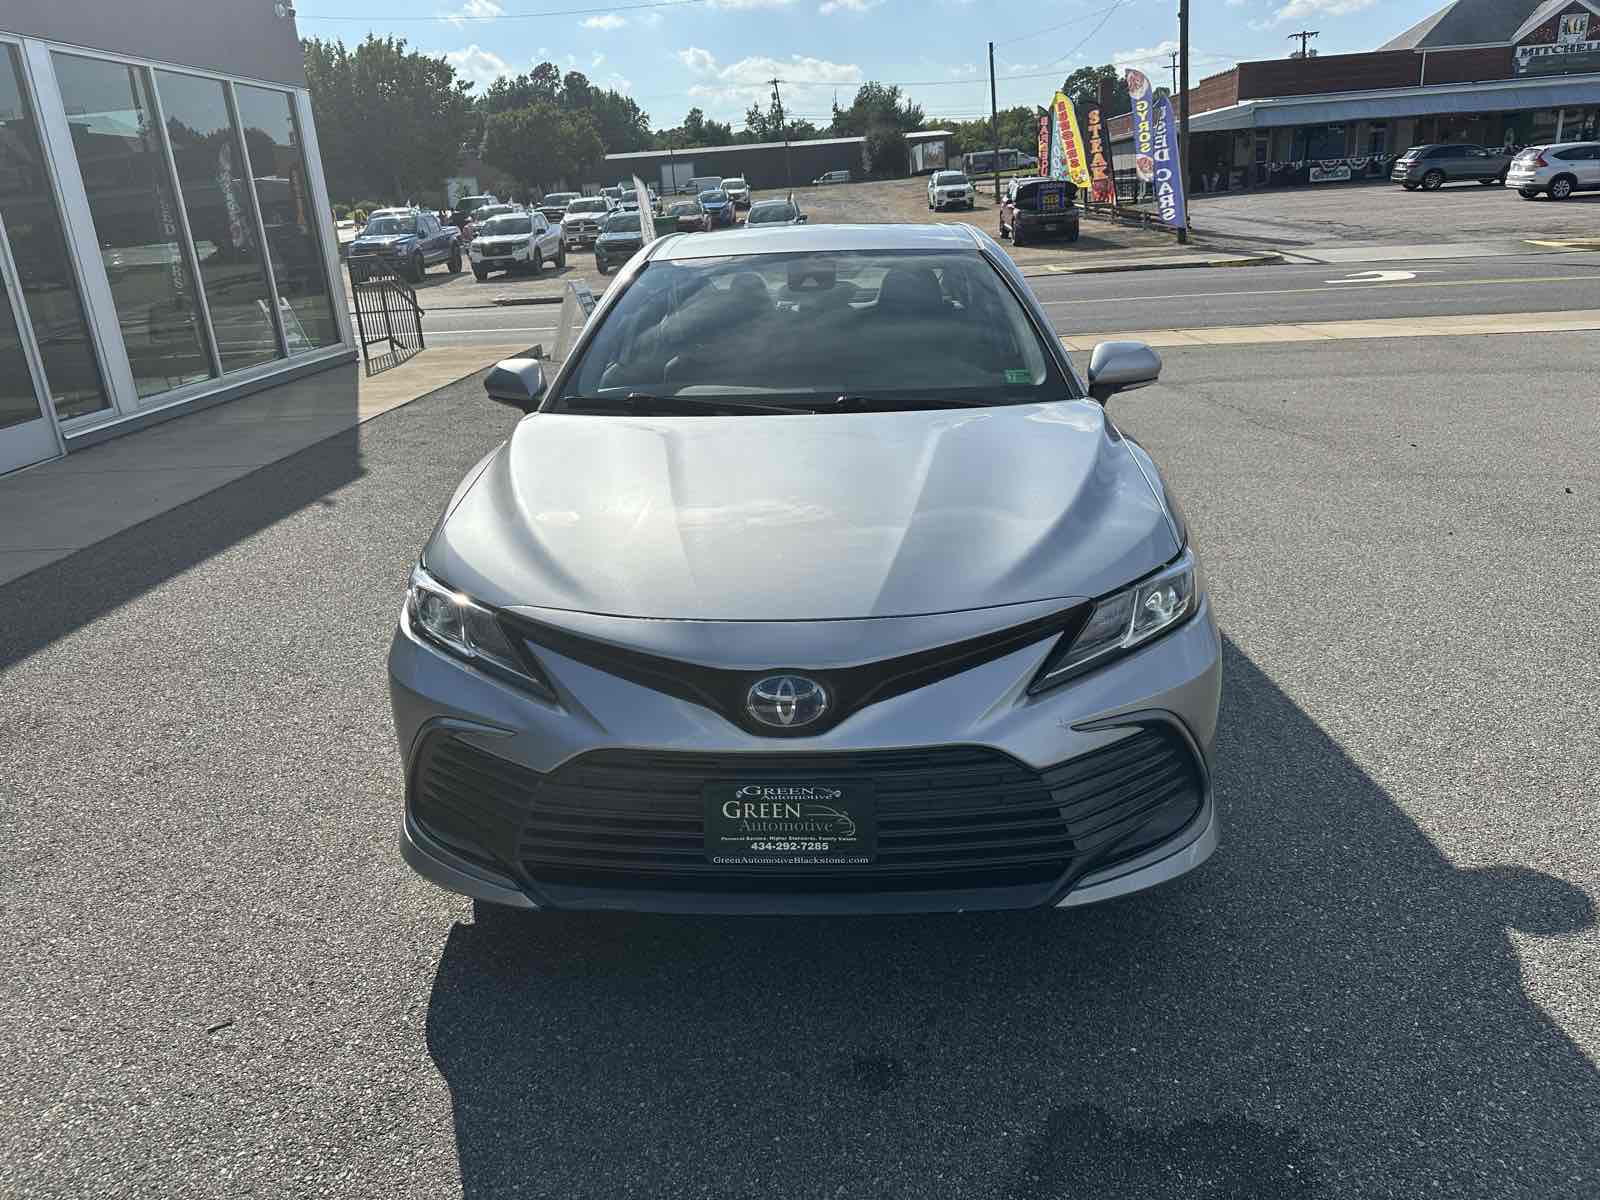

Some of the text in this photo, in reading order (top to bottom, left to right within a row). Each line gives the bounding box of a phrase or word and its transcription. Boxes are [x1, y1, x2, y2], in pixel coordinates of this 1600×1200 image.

[1087, 109, 1109, 180] STEAK
[741, 785, 814, 796] GREEN
[722, 800, 801, 819] GREEN
[739, 818, 833, 832] Automotive
[751, 842, 829, 850] 434-292-7285
[713, 856, 869, 864] GreenAutomotiveBlackstone.com
